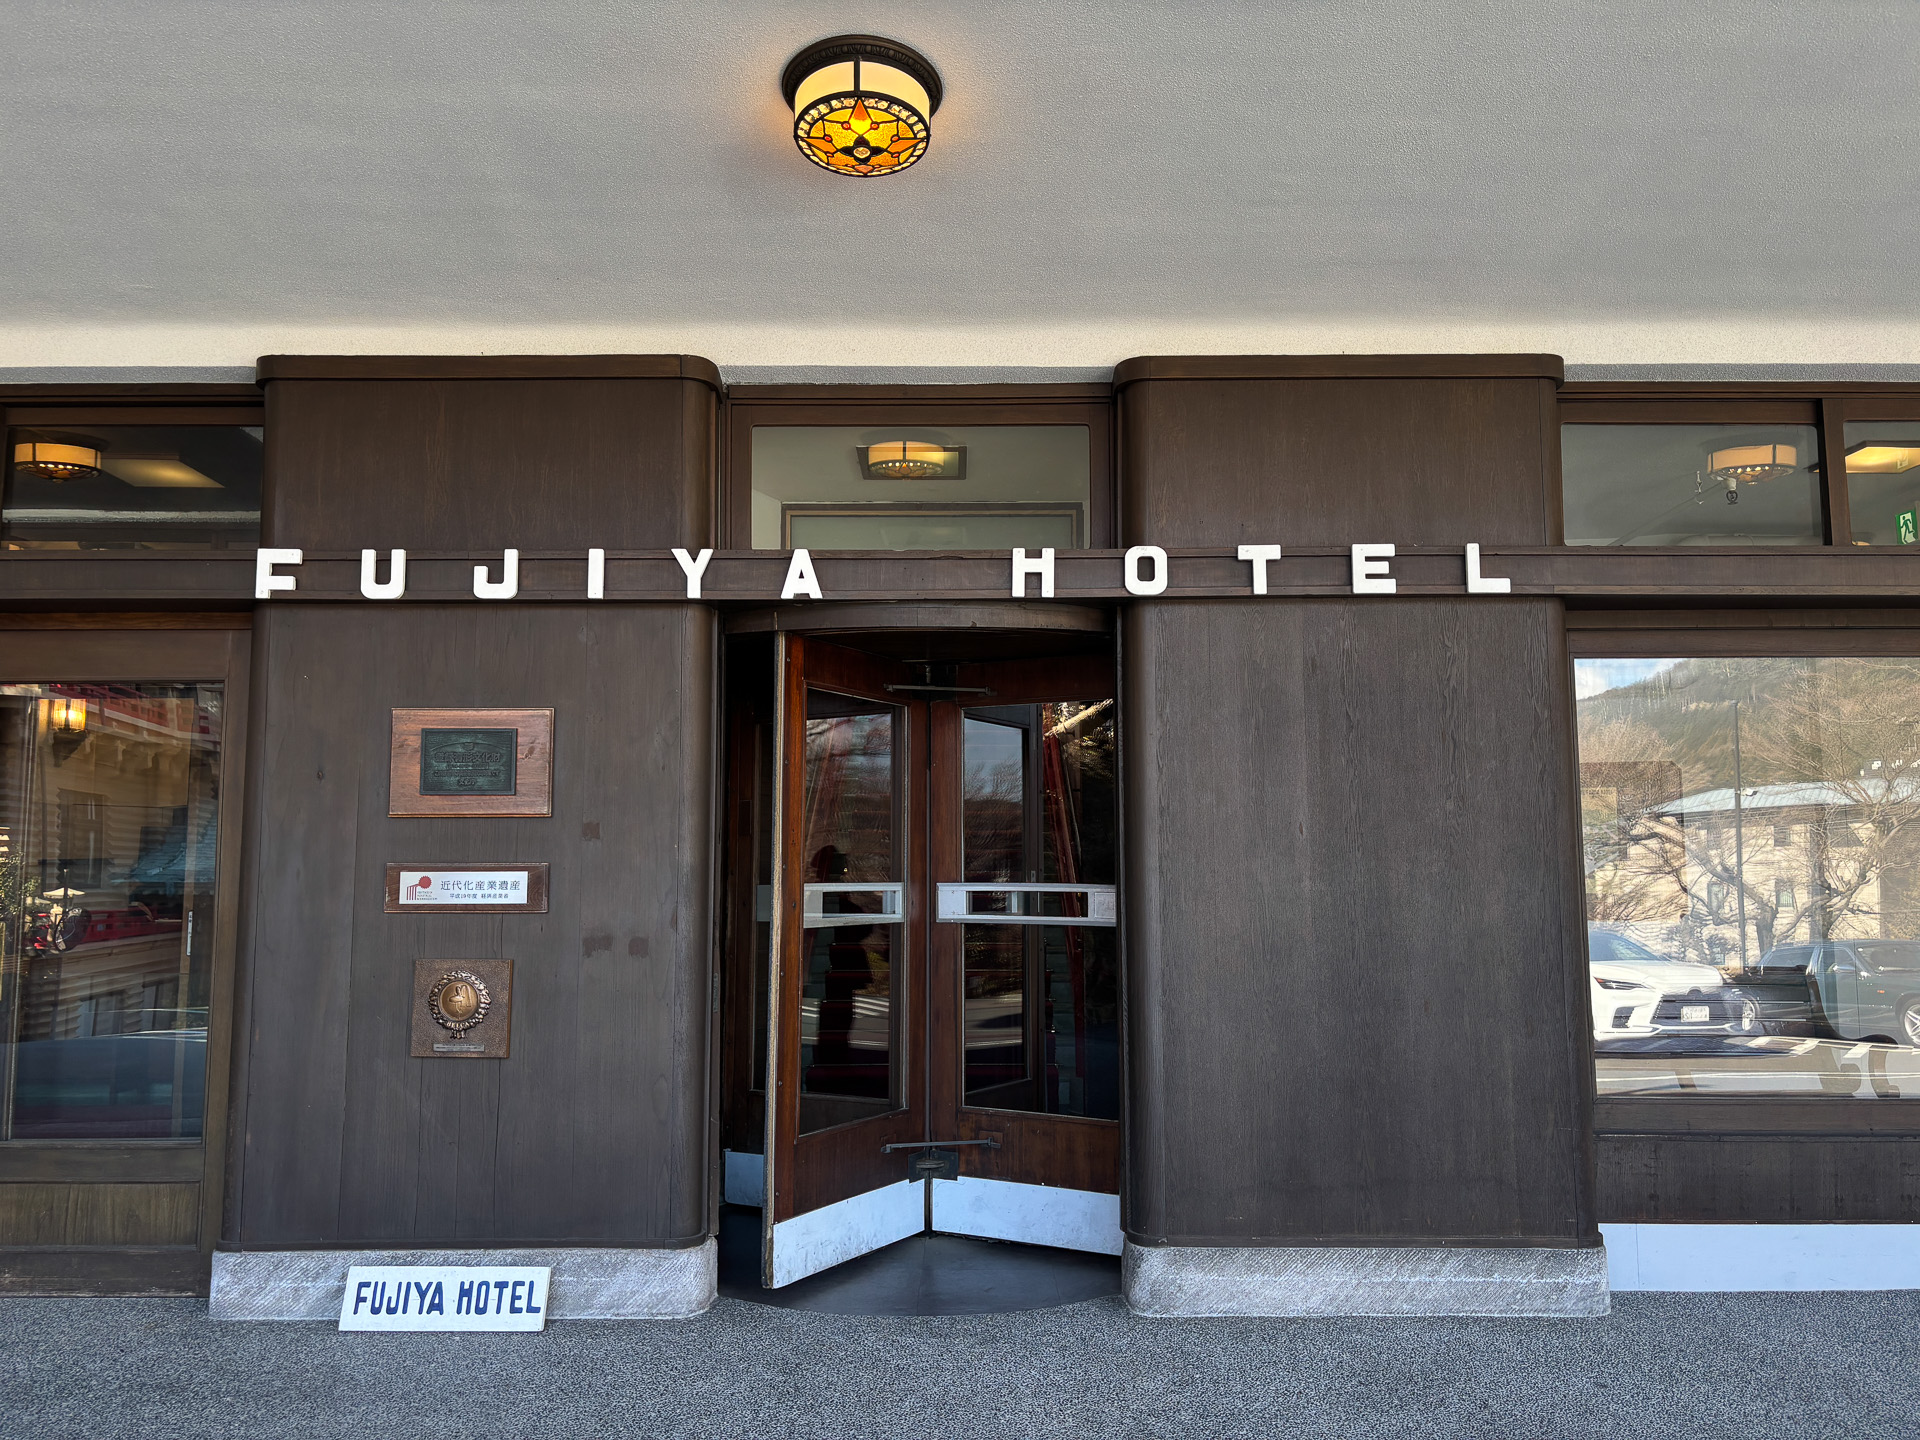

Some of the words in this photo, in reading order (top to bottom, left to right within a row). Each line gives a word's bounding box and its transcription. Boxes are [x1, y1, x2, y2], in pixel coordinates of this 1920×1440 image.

[255, 548, 823, 600] FUJIYA
[1011, 543, 1512, 598] HOTEL
[440, 880, 521, 891] 近代化産業遺産
[352, 1281, 444, 1315] FUJIYA
[456, 1280, 542, 1315] HOTEL
